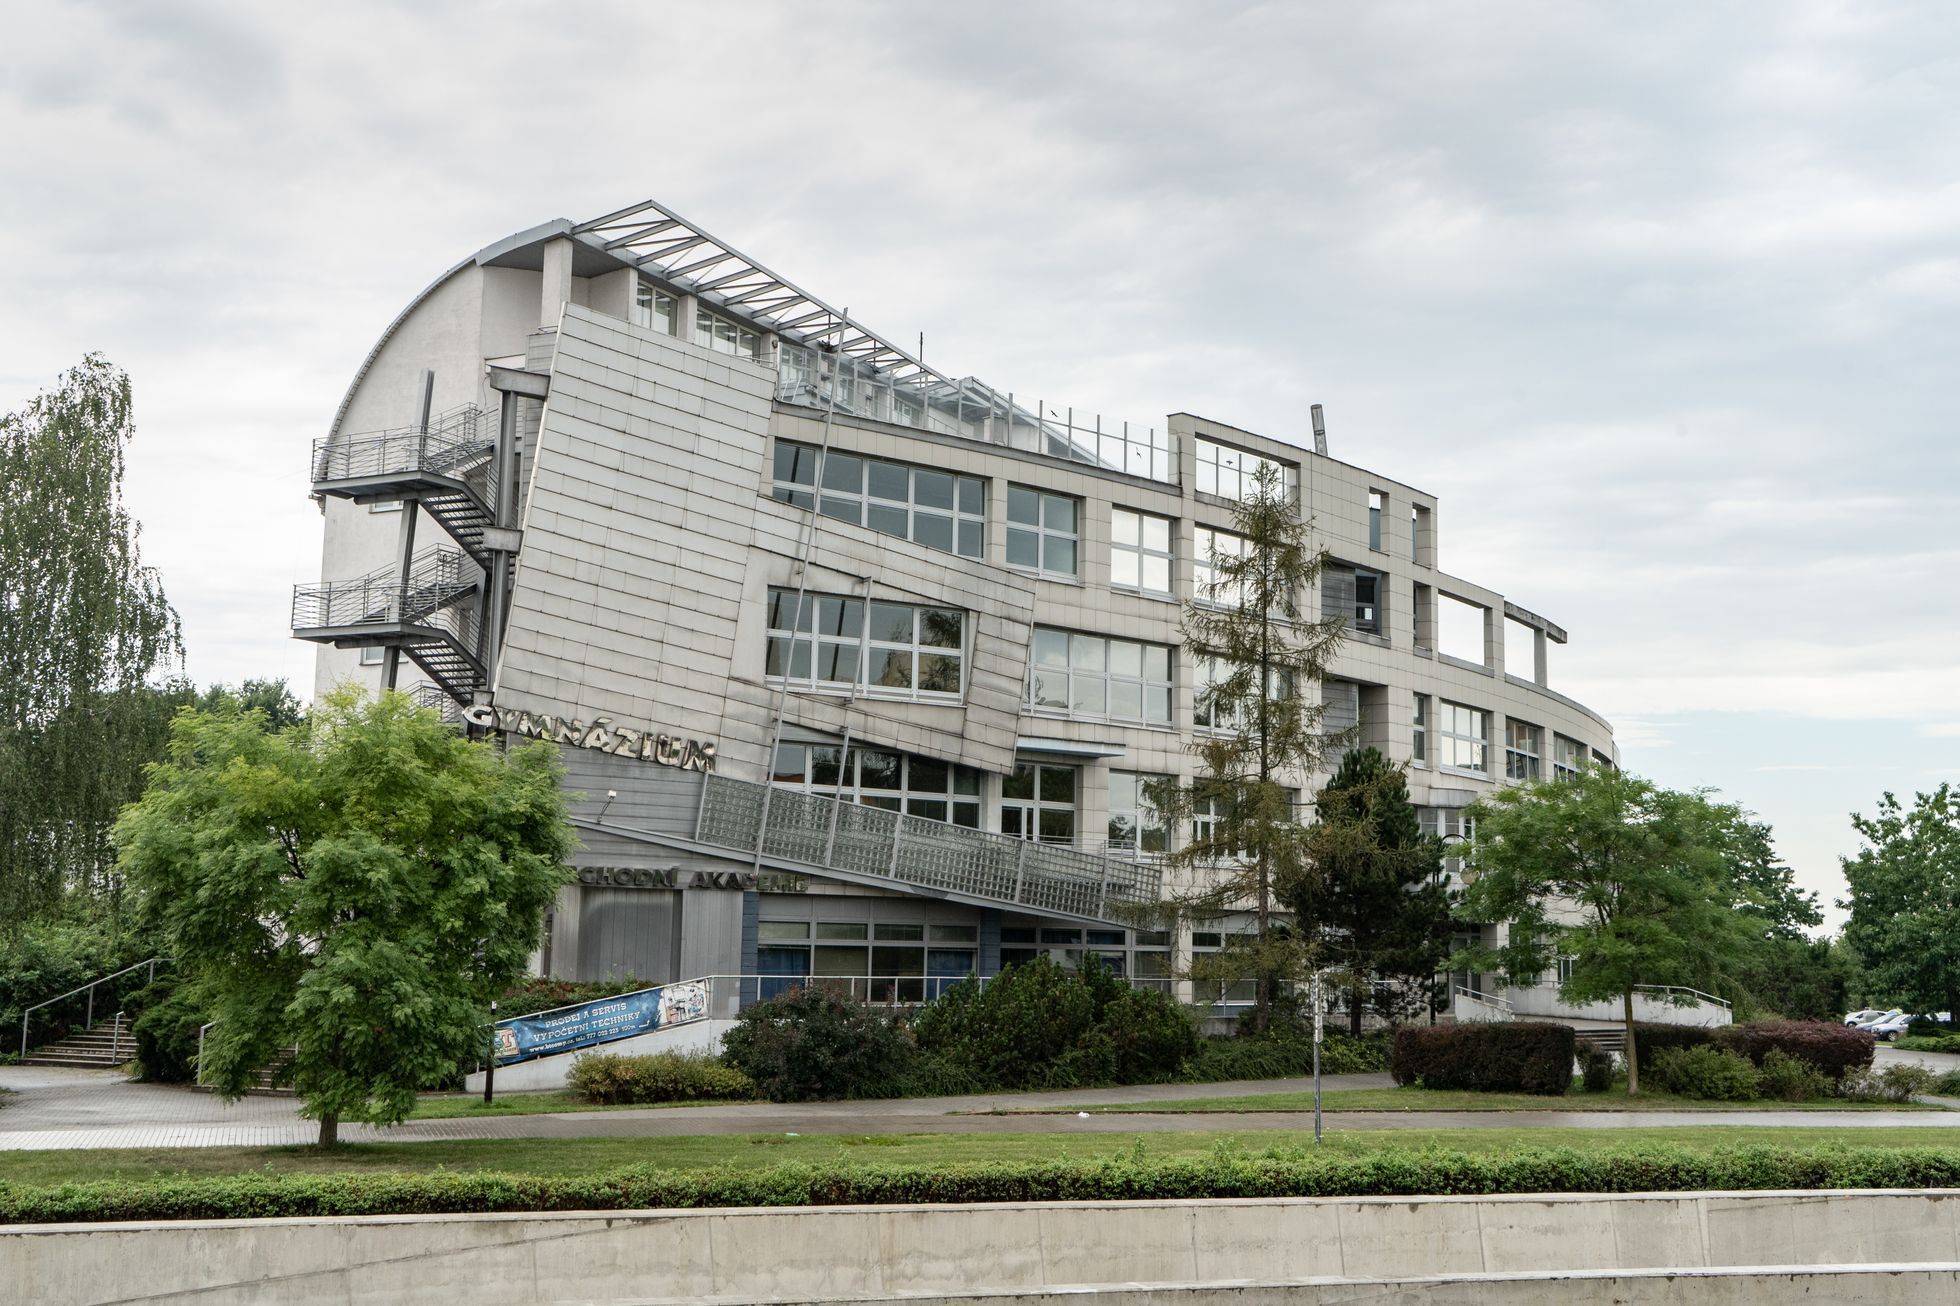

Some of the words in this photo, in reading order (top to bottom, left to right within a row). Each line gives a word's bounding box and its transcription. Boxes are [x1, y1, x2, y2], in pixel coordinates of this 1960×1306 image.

[462, 703, 718, 773] GYMNÁZIUM
[566, 865, 679, 888] CHODNÍ
[545, 1013, 580, 1028] PRODEJ
[583, 1010, 590, 1019] A
[591, 1002, 627, 1017] SERVIS
[591, 1011, 641, 1028] TECHNIKY
[586, 1032, 597, 1041] 777
